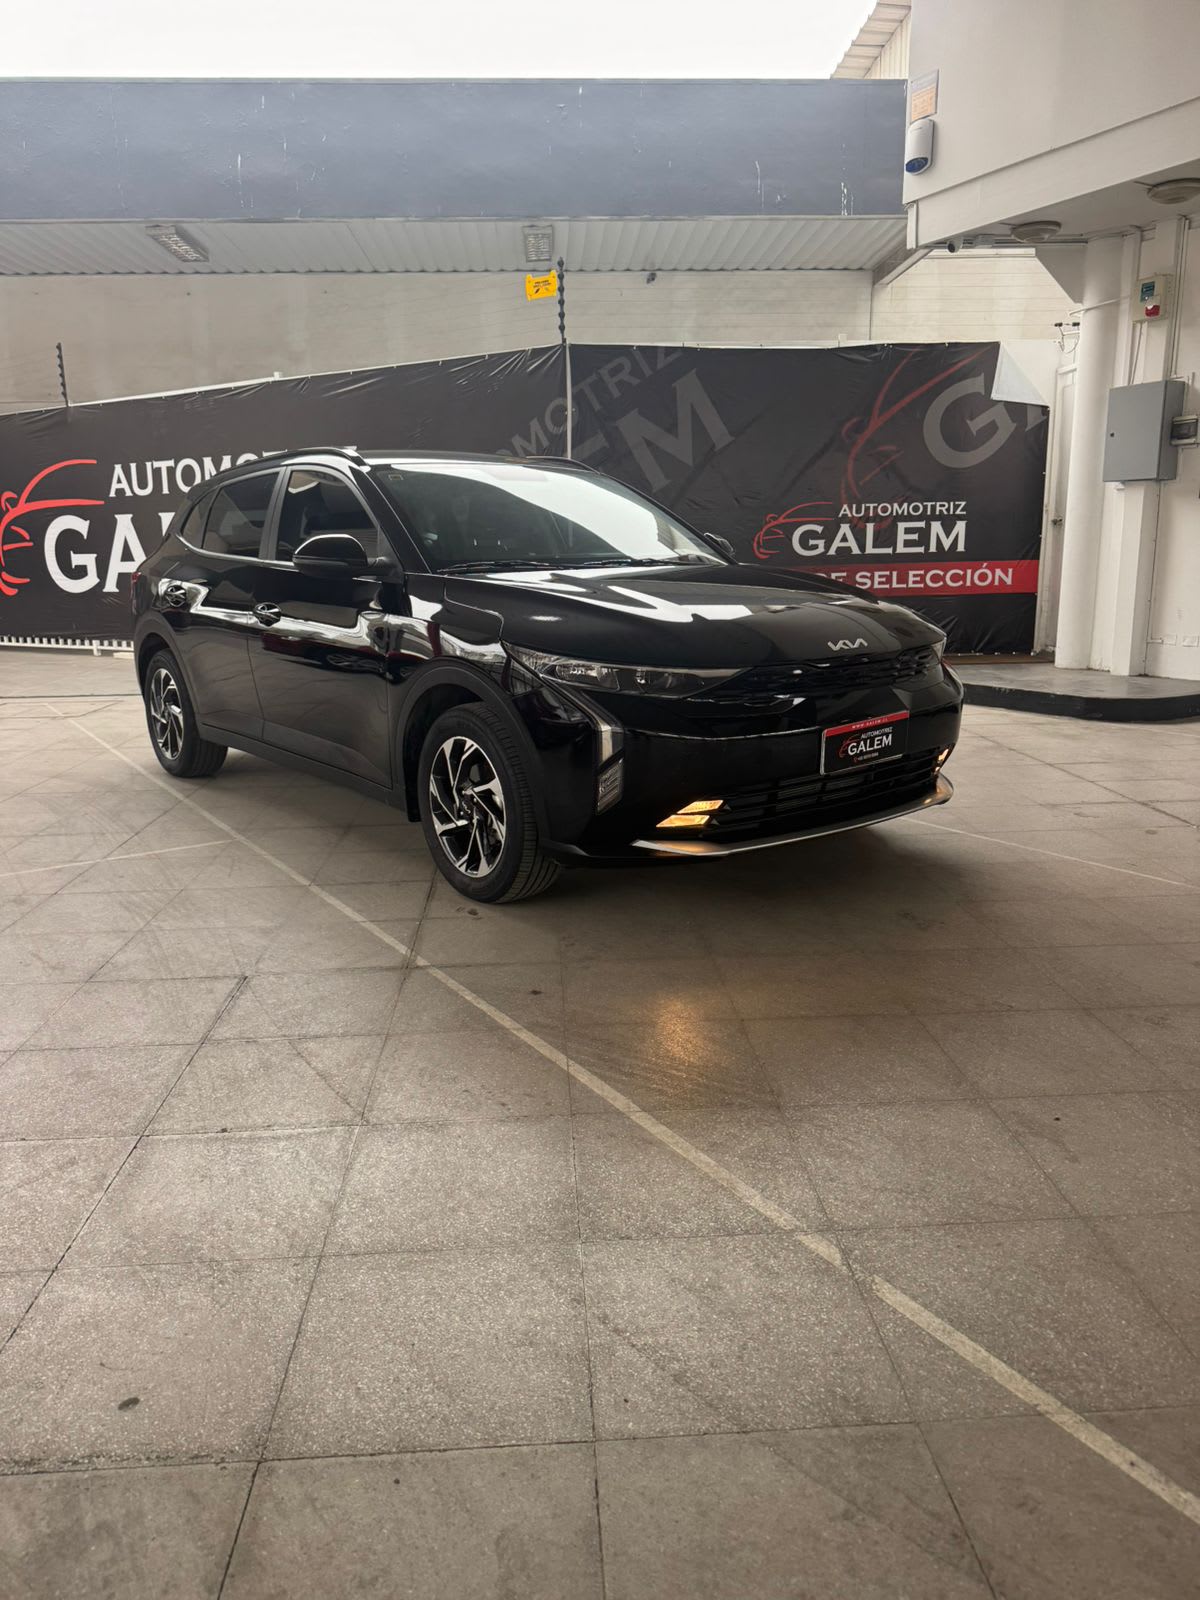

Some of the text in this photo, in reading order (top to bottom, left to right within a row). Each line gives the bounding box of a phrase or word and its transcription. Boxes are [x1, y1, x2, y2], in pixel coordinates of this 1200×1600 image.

[839, 501, 966, 518] AUTOMOTRIZ
[792, 521, 967, 556] GALEM
[856, 563, 1013, 589] SELECCIÓN
[848, 734, 892, 755] GALEM
